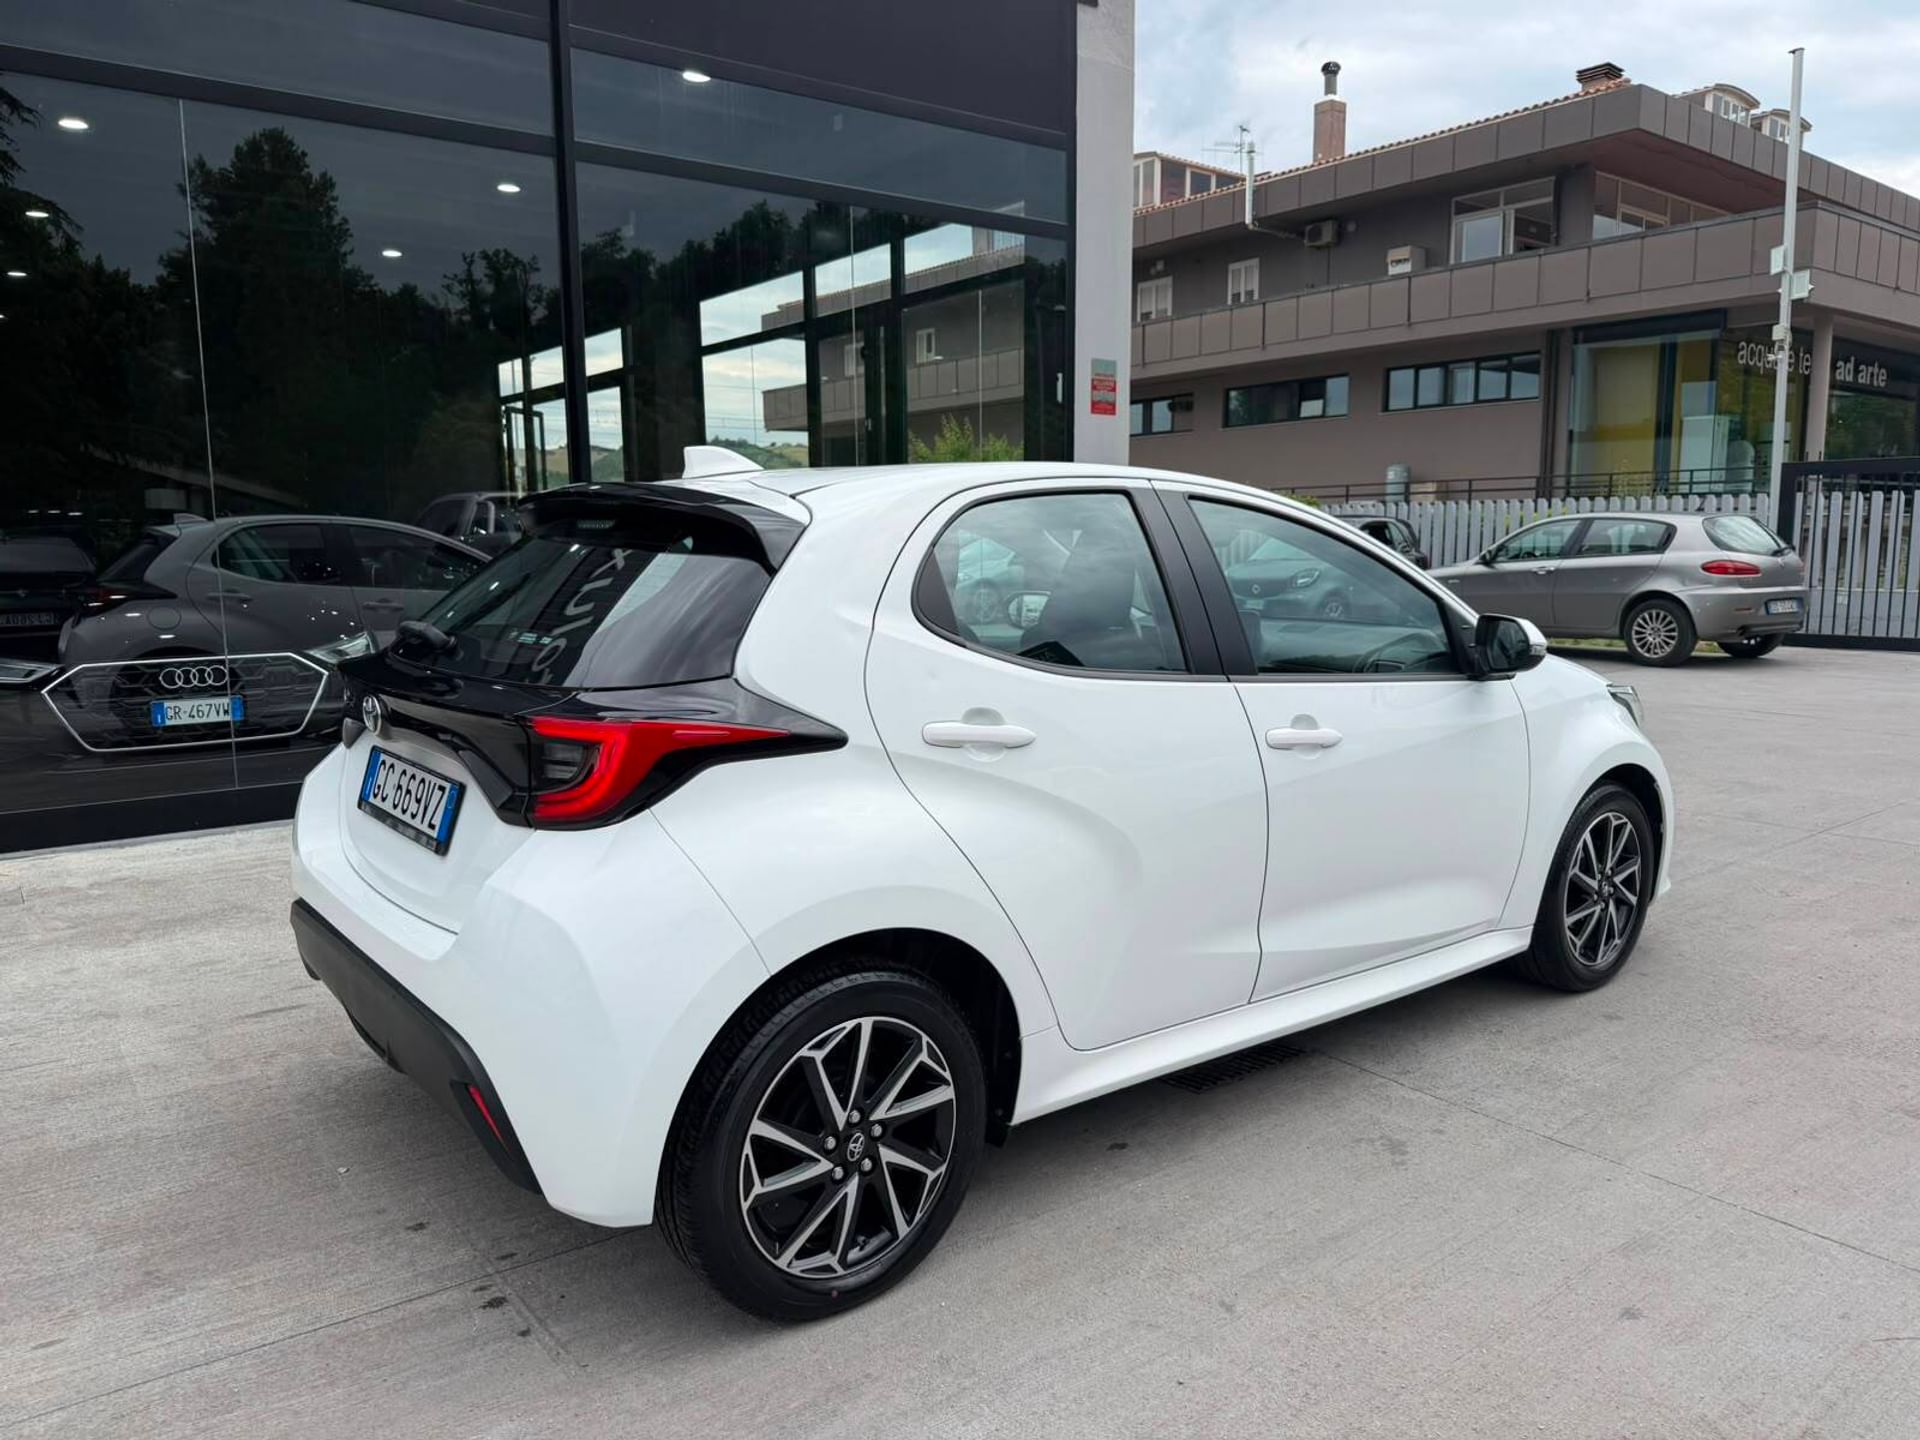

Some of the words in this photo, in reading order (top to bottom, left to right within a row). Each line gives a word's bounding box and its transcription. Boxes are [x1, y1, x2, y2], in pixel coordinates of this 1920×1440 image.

[1799, 346, 1811, 375] te
[1835, 356, 1855, 382] ad
[1858, 361, 1887, 387] arte
